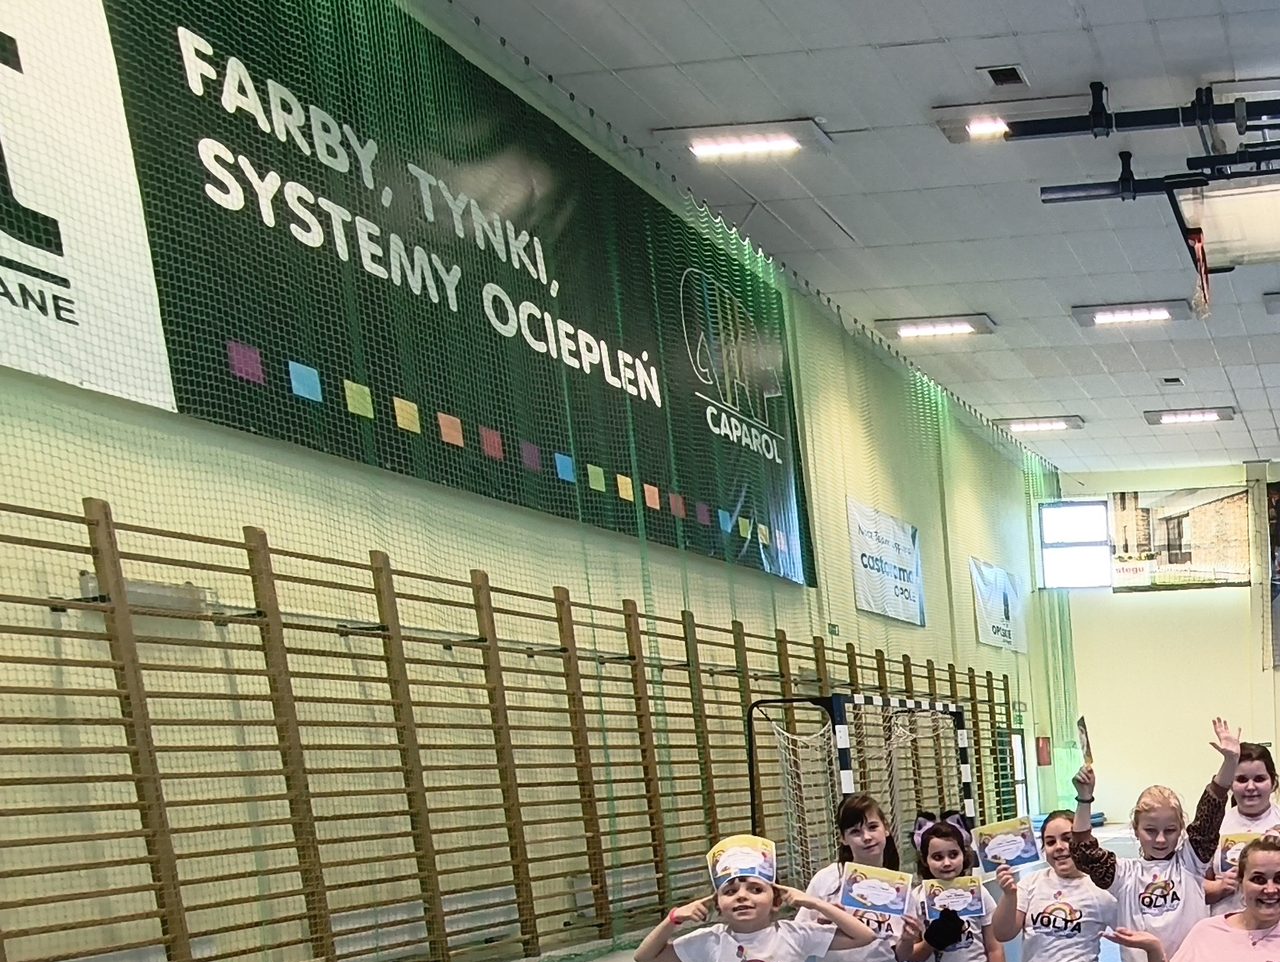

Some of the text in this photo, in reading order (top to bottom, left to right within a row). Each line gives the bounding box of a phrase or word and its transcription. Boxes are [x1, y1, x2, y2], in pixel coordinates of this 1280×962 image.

[177, 26, 392, 206] FARBY,
[407, 162, 561, 297] TYNKI,
[198, 137, 462, 313] SYSTEMY
[483, 291, 663, 408] OCIEPLEŃ
[706, 405, 782, 464] CAPAROL
[1031, 912, 1081, 934] VOLTA
